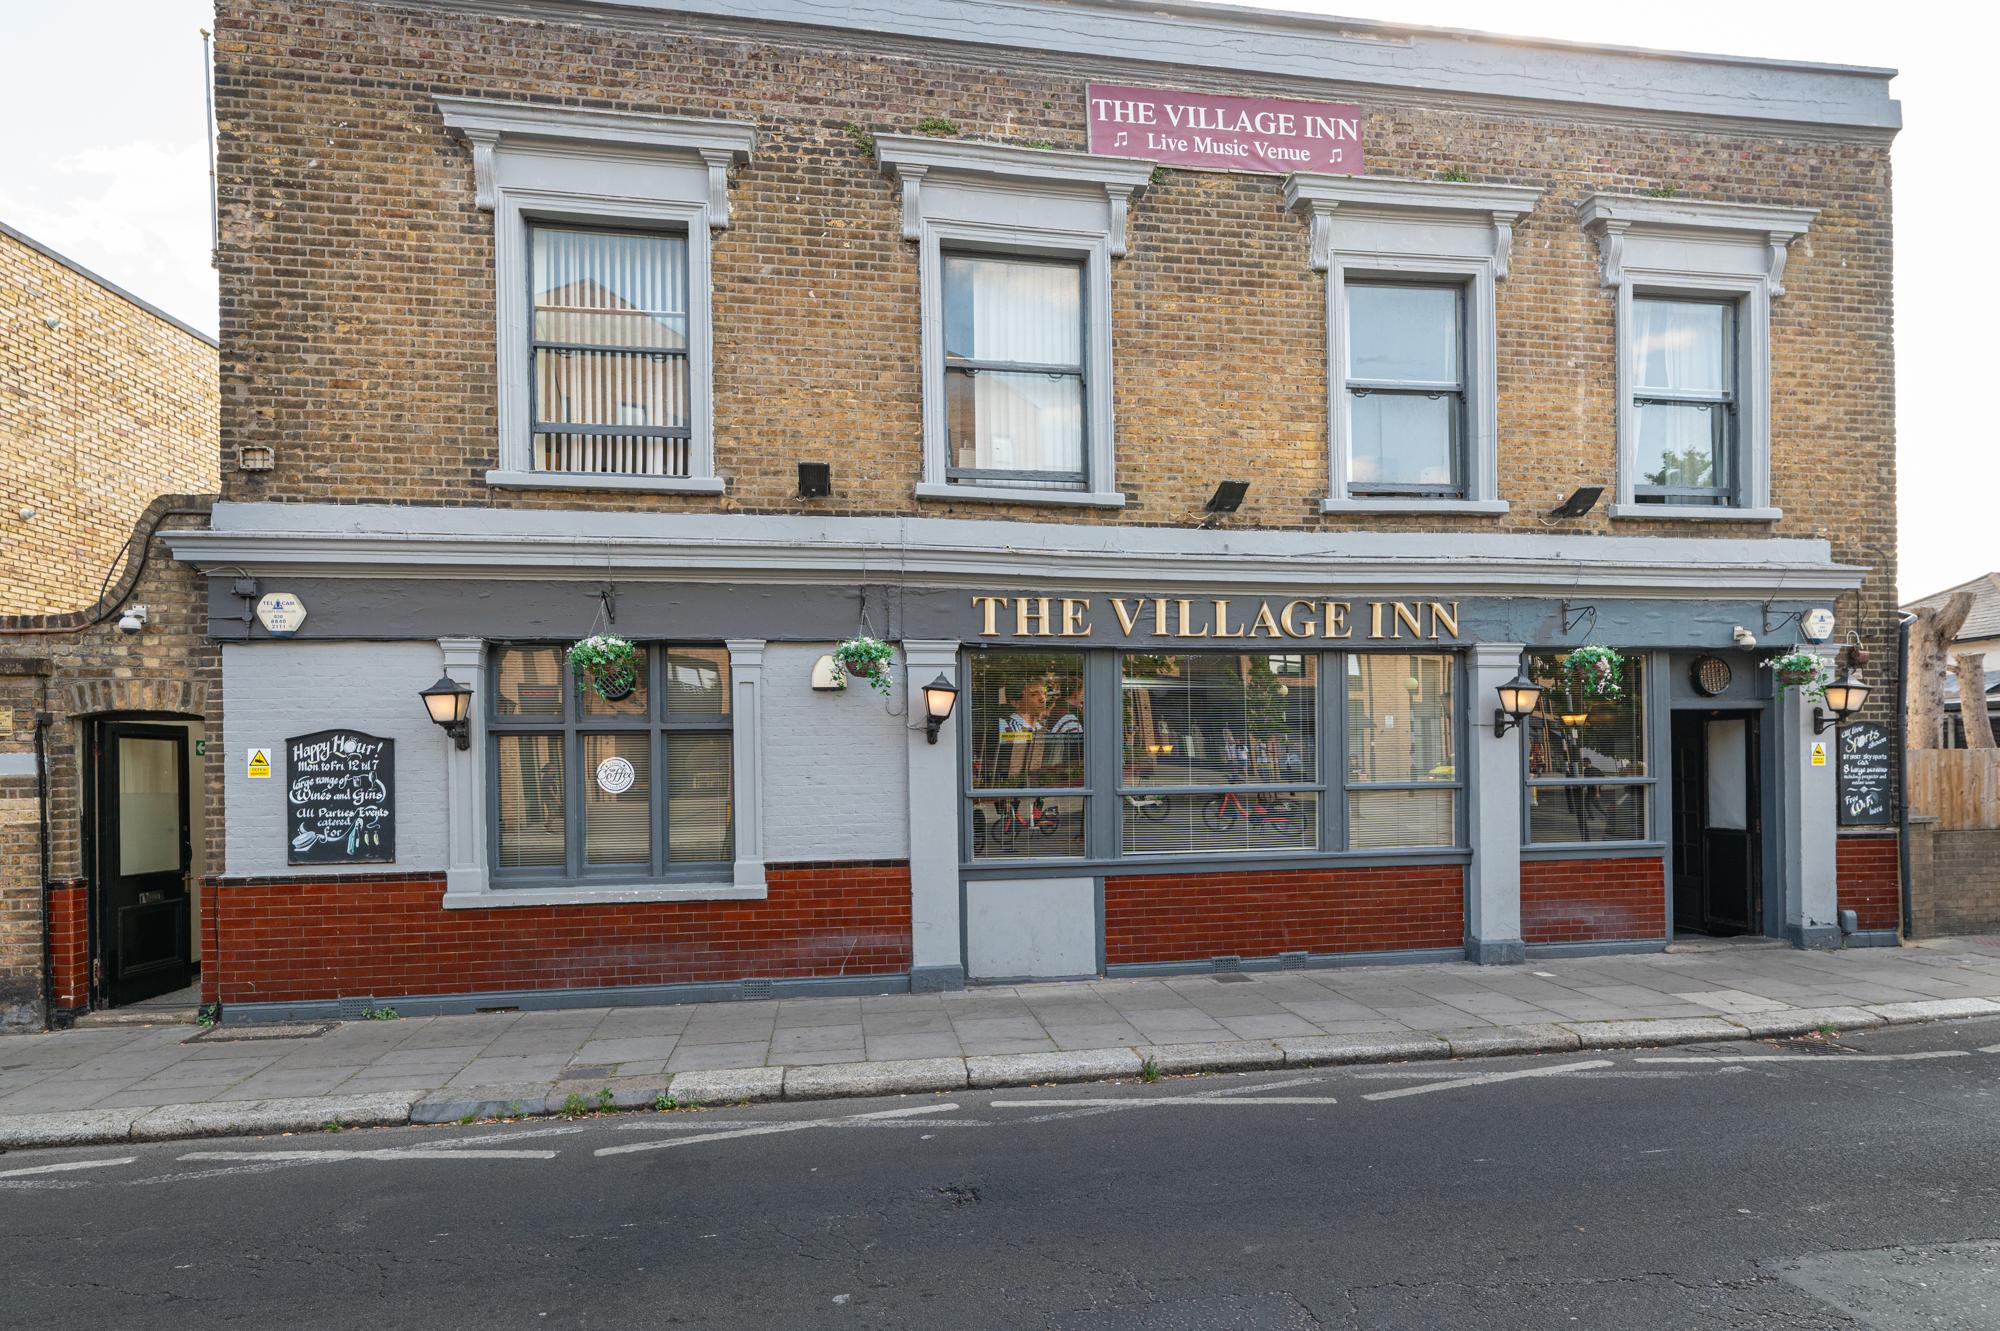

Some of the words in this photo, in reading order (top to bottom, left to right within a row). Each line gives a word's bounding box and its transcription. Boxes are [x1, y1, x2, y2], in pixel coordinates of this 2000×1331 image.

[1092, 98, 1156, 125] THE
[1163, 104, 1296, 137] VILLAGE
[1303, 115, 1359, 141] INN
[1147, 132, 1188, 152] Live
[1193, 136, 1249, 157] Music
[1253, 141, 1311, 161] Venue
[972, 595, 1091, 636] THE
[1108, 597, 1352, 639] VILLAGE
[1367, 601, 1459, 639] INN
[293, 741, 330, 762] Happy
[321, 762, 330, 771] to
[348, 760, 360, 771] 12
[372, 760, 380, 771] 7
[316, 776, 338, 789] range
[339, 774, 350, 789] of
[296, 788, 331, 801] Wines
[333, 788, 351, 800] and
[352, 789, 383, 805] Gins
[317, 817, 351, 827] catered
